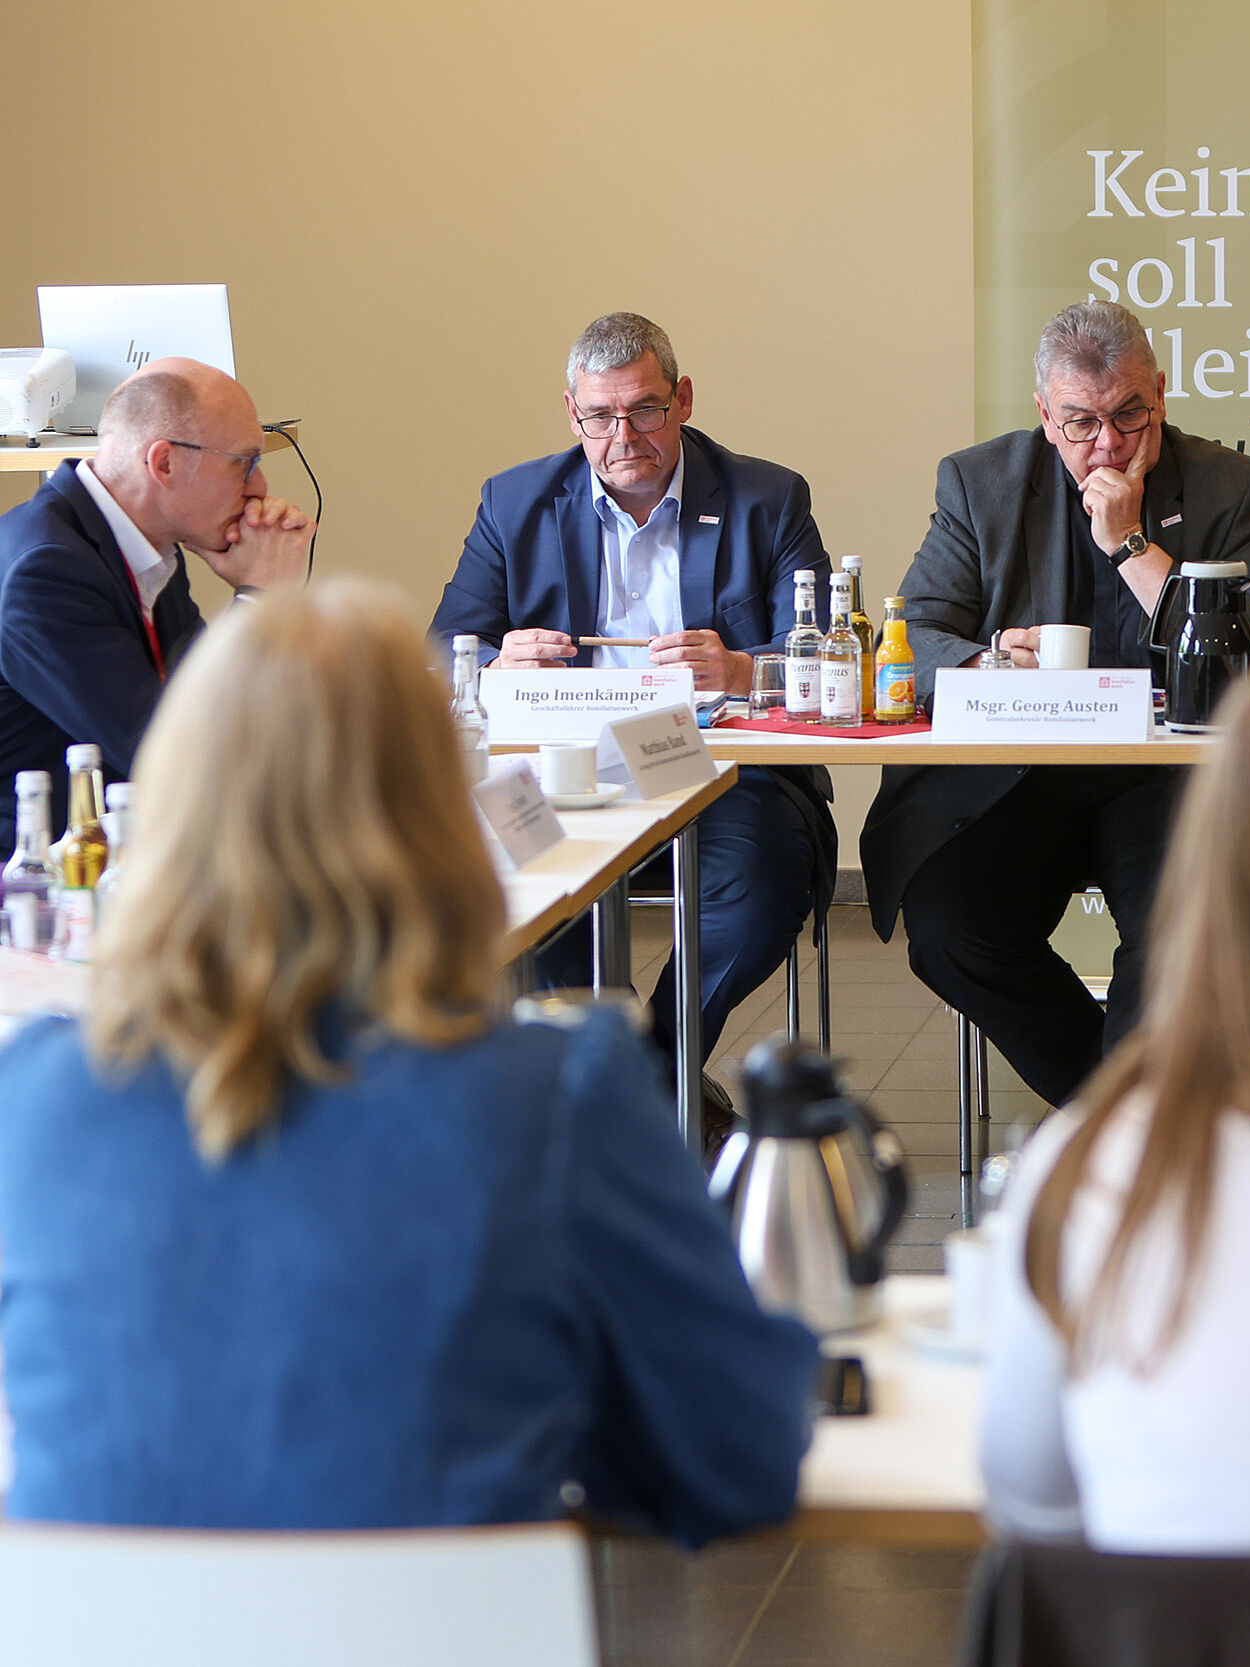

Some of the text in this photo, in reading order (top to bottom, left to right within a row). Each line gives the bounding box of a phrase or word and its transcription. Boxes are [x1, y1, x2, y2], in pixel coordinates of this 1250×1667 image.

[1087, 237, 1233, 309] soll
[515, 688, 658, 704] Ingo Imenkämper
[966, 699, 1118, 716] Msgr. Georg Austen
